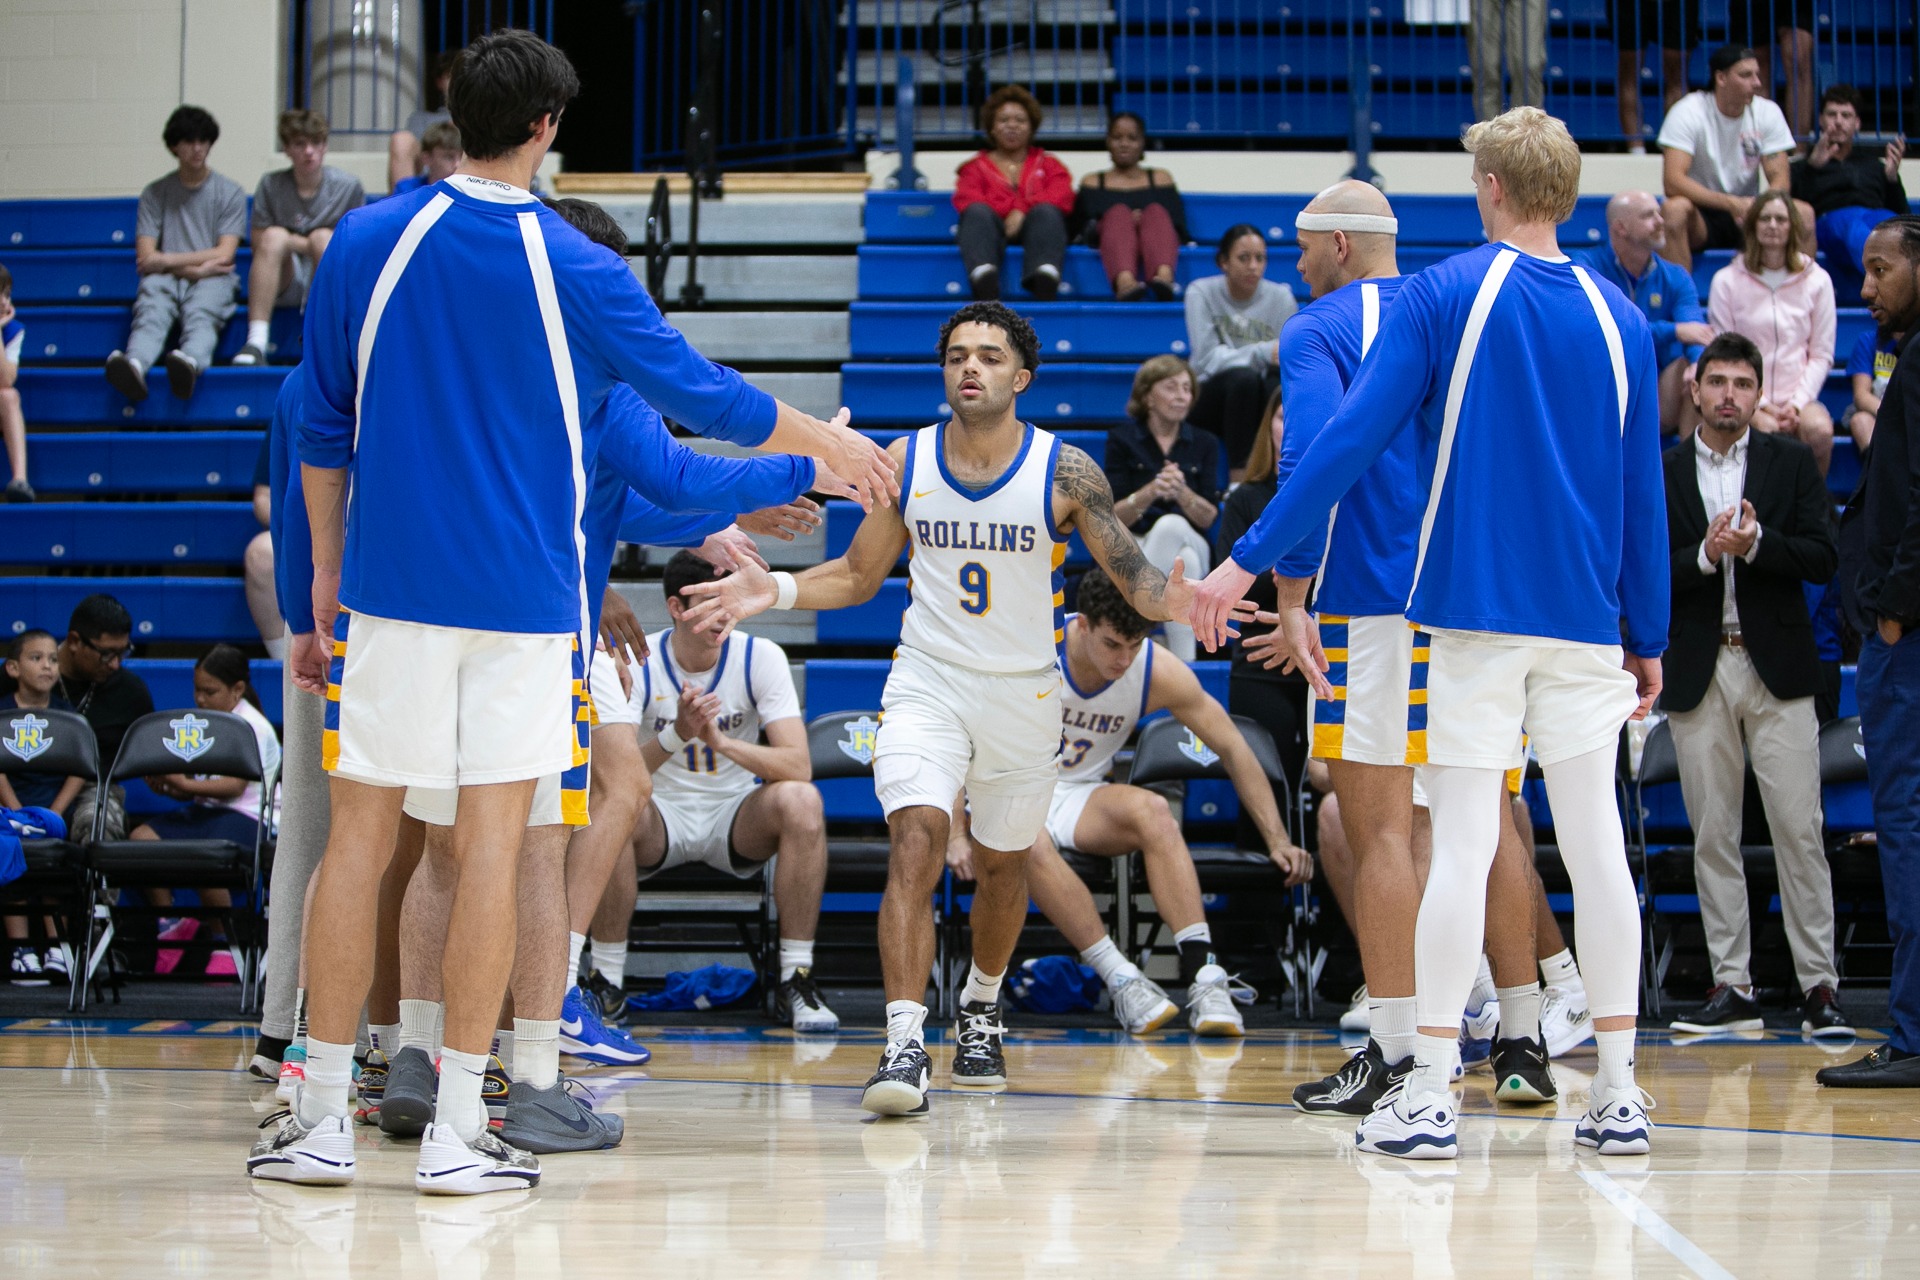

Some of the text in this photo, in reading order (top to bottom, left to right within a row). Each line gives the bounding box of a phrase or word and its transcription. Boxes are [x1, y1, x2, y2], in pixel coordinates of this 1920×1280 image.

[466, 177, 512, 191] NIKE PRO
[915, 519, 1036, 553] ROLLINS
[958, 560, 991, 617] 9
[1062, 707, 1125, 734] LLINS
[683, 743, 718, 775] 11
